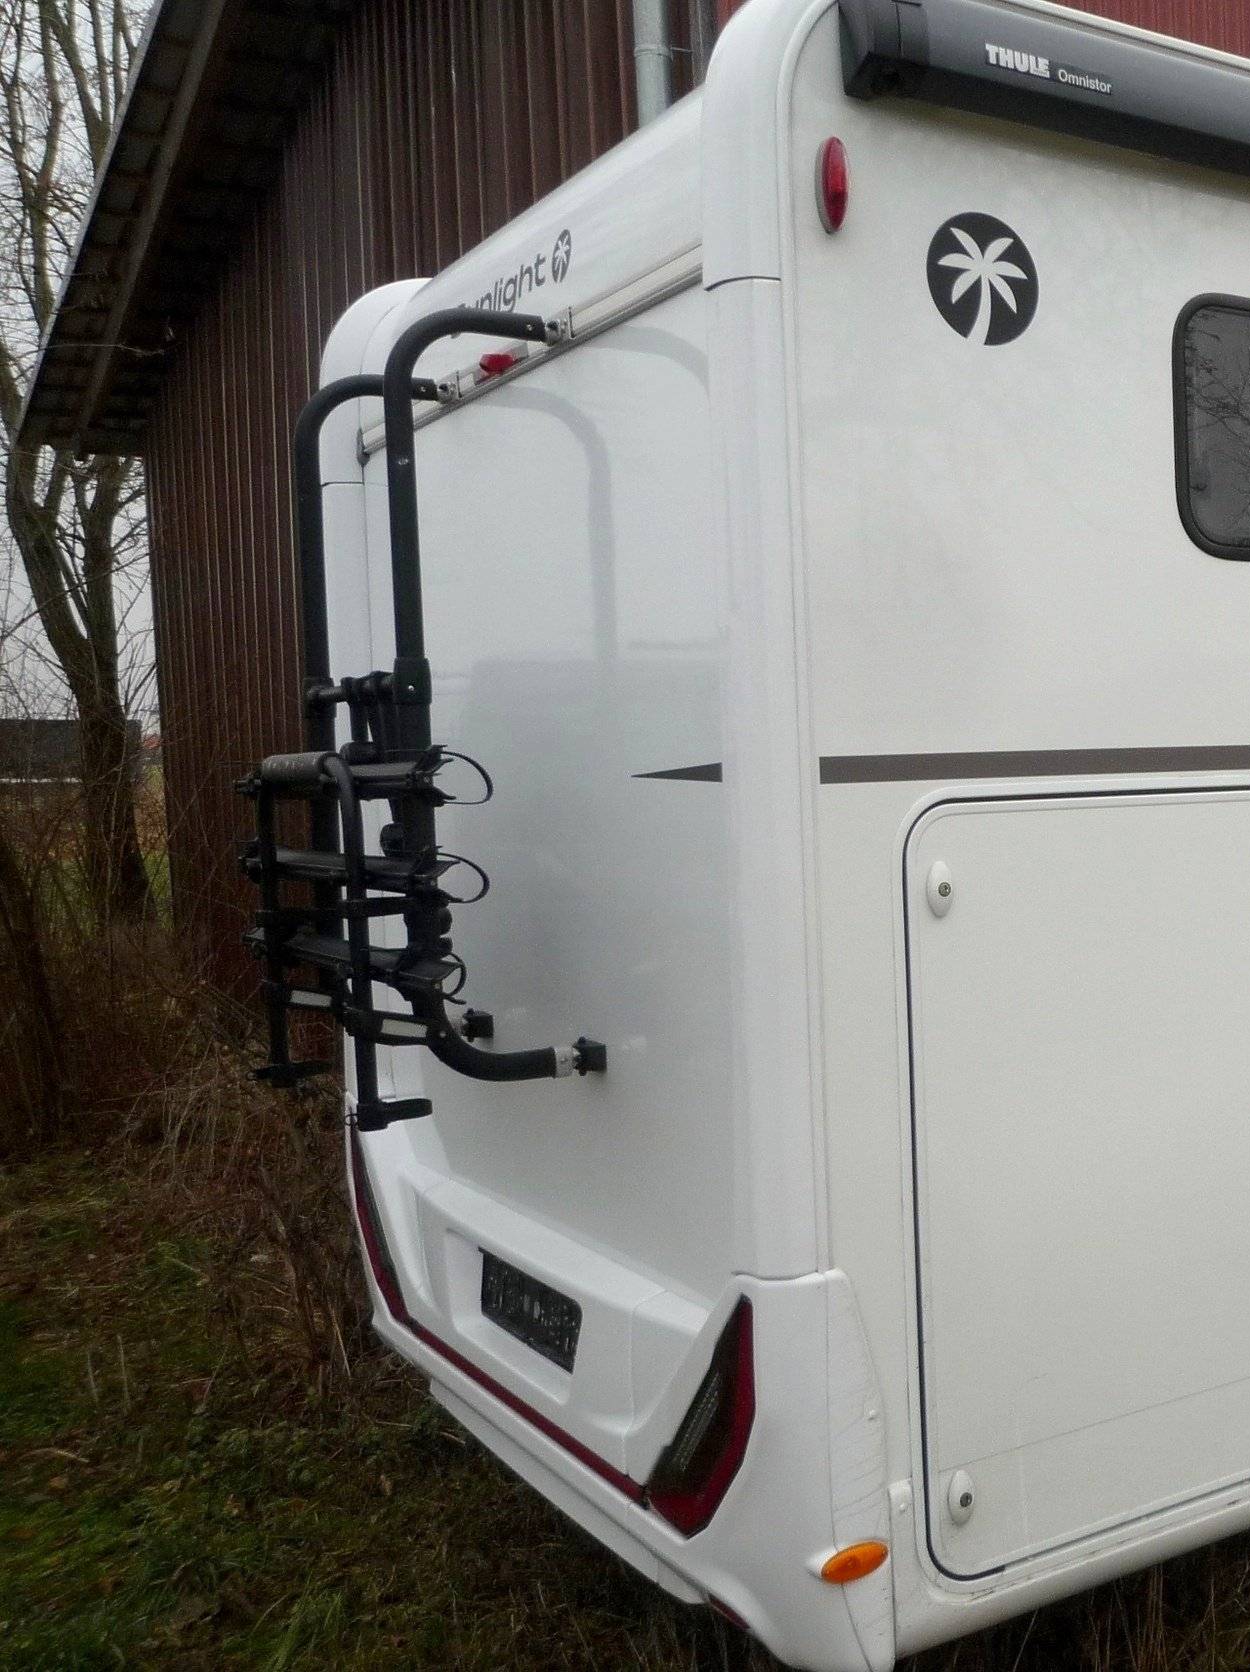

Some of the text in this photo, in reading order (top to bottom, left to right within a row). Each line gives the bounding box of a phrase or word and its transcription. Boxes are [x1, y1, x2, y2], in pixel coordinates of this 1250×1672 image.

[985, 42, 1112, 94] THULE Omnistor
[456, 253, 547, 314] nlight
